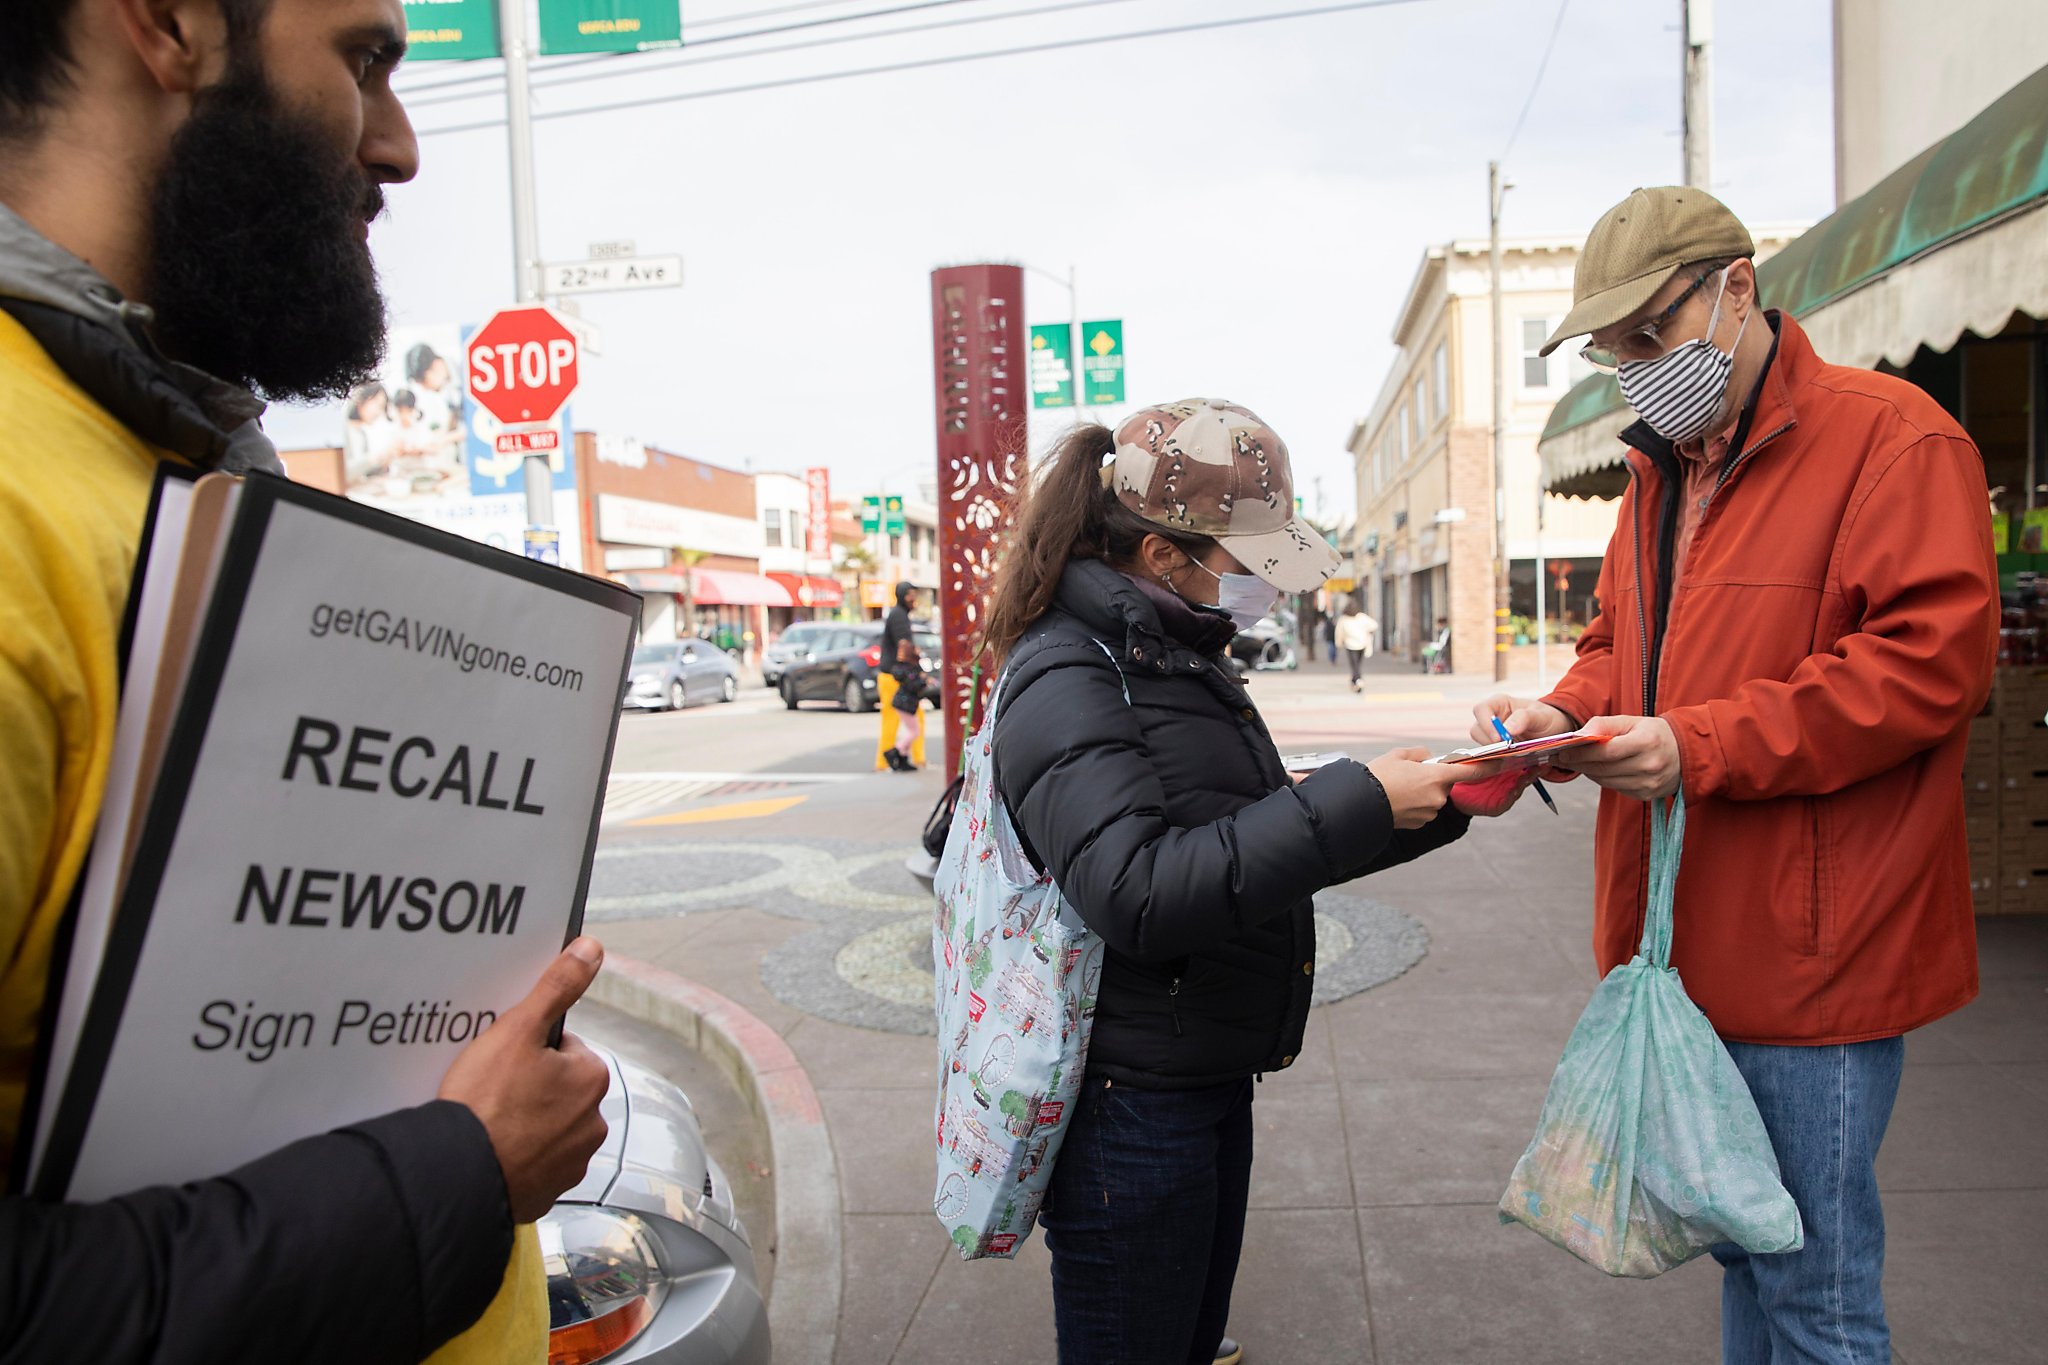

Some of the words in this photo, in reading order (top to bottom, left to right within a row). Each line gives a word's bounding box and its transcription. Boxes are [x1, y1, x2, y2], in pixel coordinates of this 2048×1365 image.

[561, 267, 609, 287] 22nd
[626, 265, 665, 281] Ave
[470, 339, 575, 393] STOP
[497, 435, 522, 450] ALL
[528, 432, 556, 449] WAY
[310, 603, 584, 691] getGAVINgone.com
[281, 716, 545, 816] RECALL
[234, 864, 526, 935] NEWSOM
[193, 1000, 315, 1062] Sign
